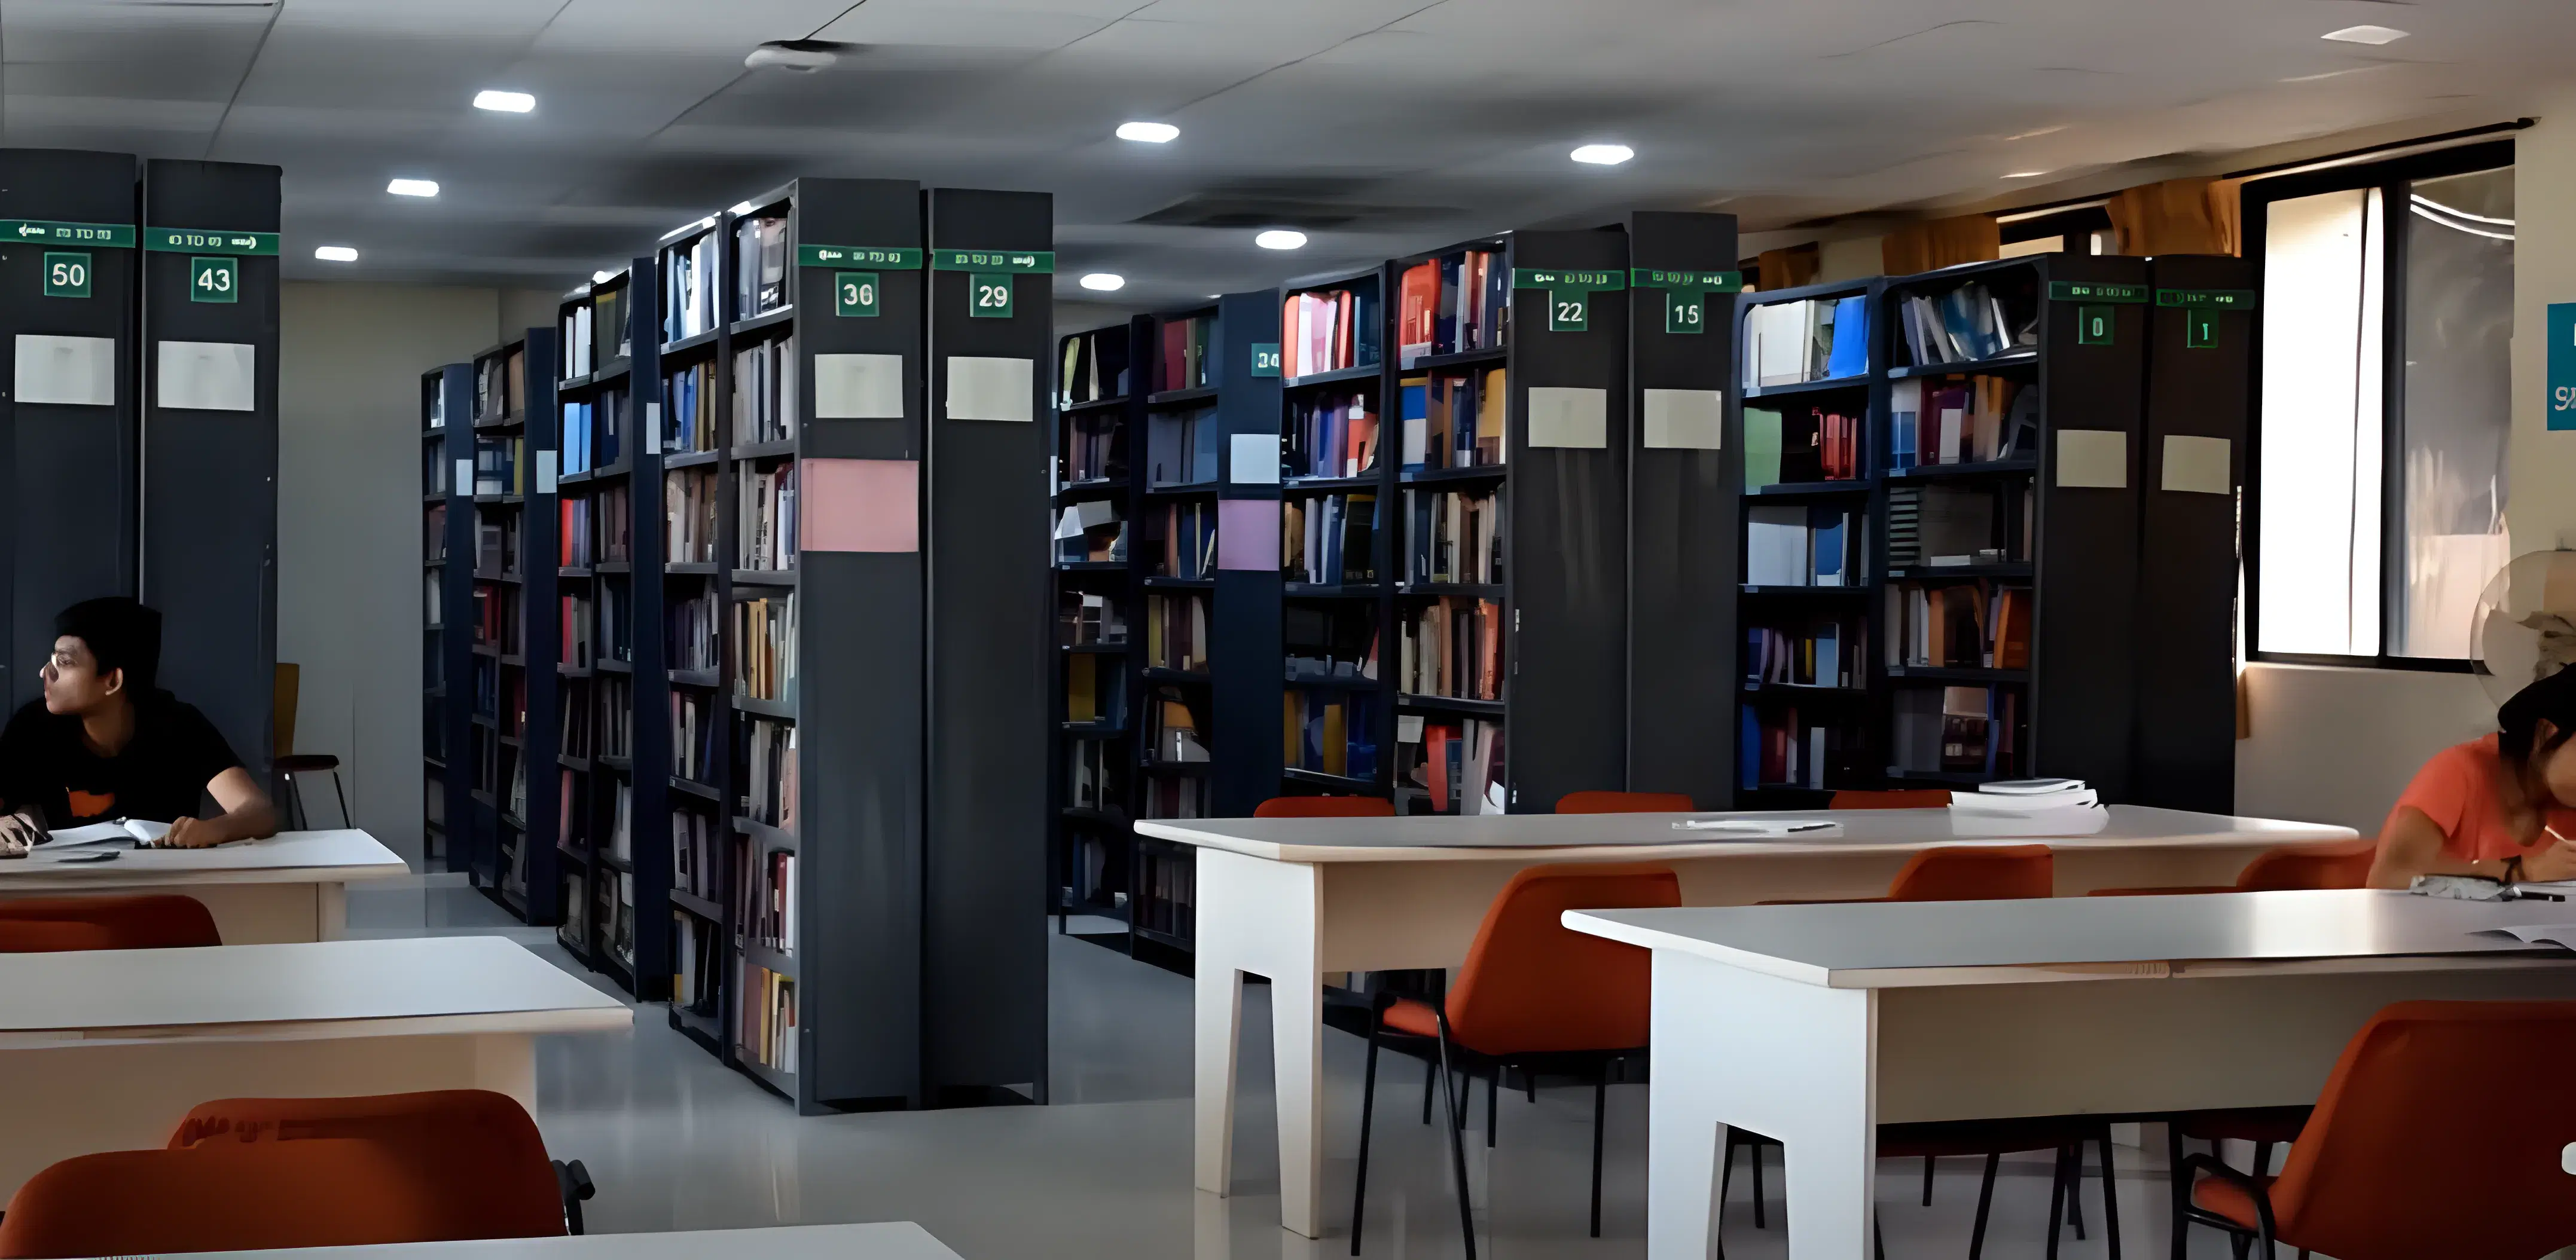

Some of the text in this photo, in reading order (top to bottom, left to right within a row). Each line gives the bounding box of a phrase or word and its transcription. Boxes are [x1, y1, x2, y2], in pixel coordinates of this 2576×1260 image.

[53, 264, 84, 286] 50
[198, 268, 230, 291] 43
[844, 284, 872, 305] 36
[979, 286, 1007, 307] 29
[1558, 302, 1582, 321] 22
[1675, 305, 1698, 323] 15
